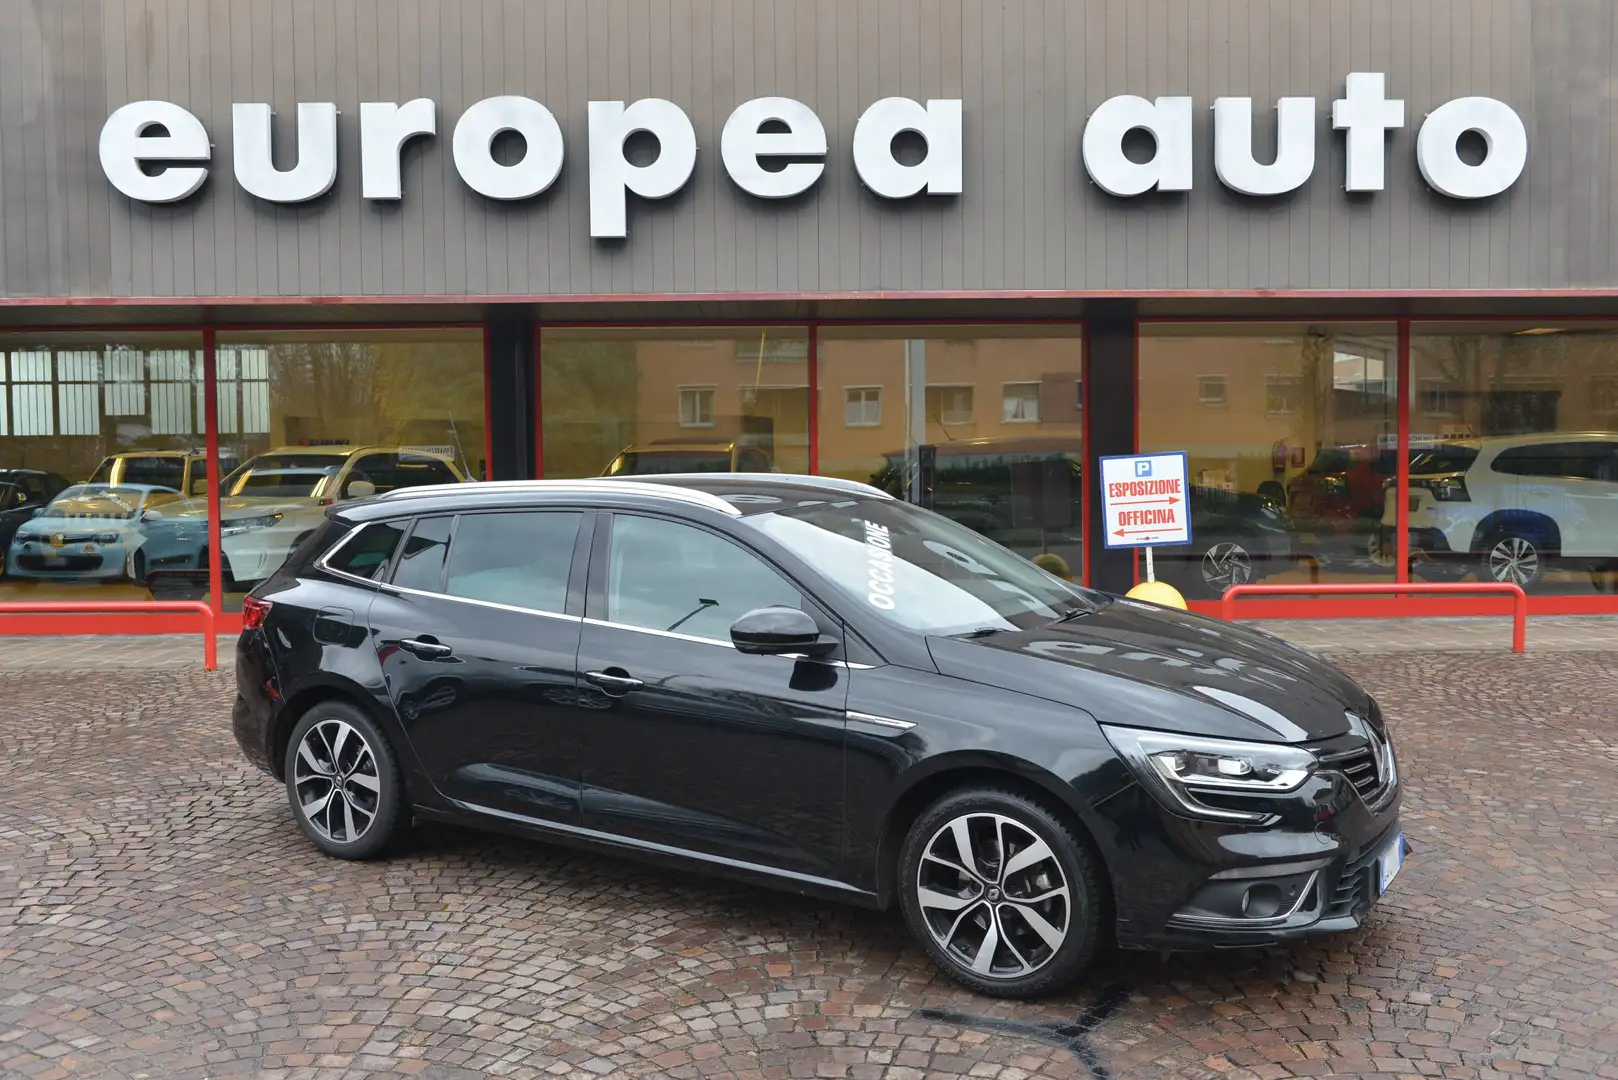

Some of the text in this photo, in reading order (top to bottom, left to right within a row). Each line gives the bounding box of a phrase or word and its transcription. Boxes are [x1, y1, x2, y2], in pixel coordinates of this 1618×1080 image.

[99, 72, 1528, 238] europea auto
[1137, 462, 1151, 476] P
[1109, 479, 1181, 498] ESPOSIZIONE
[1118, 508, 1175, 526] OFFICINA
[865, 520, 895, 610] OCCASIONE
